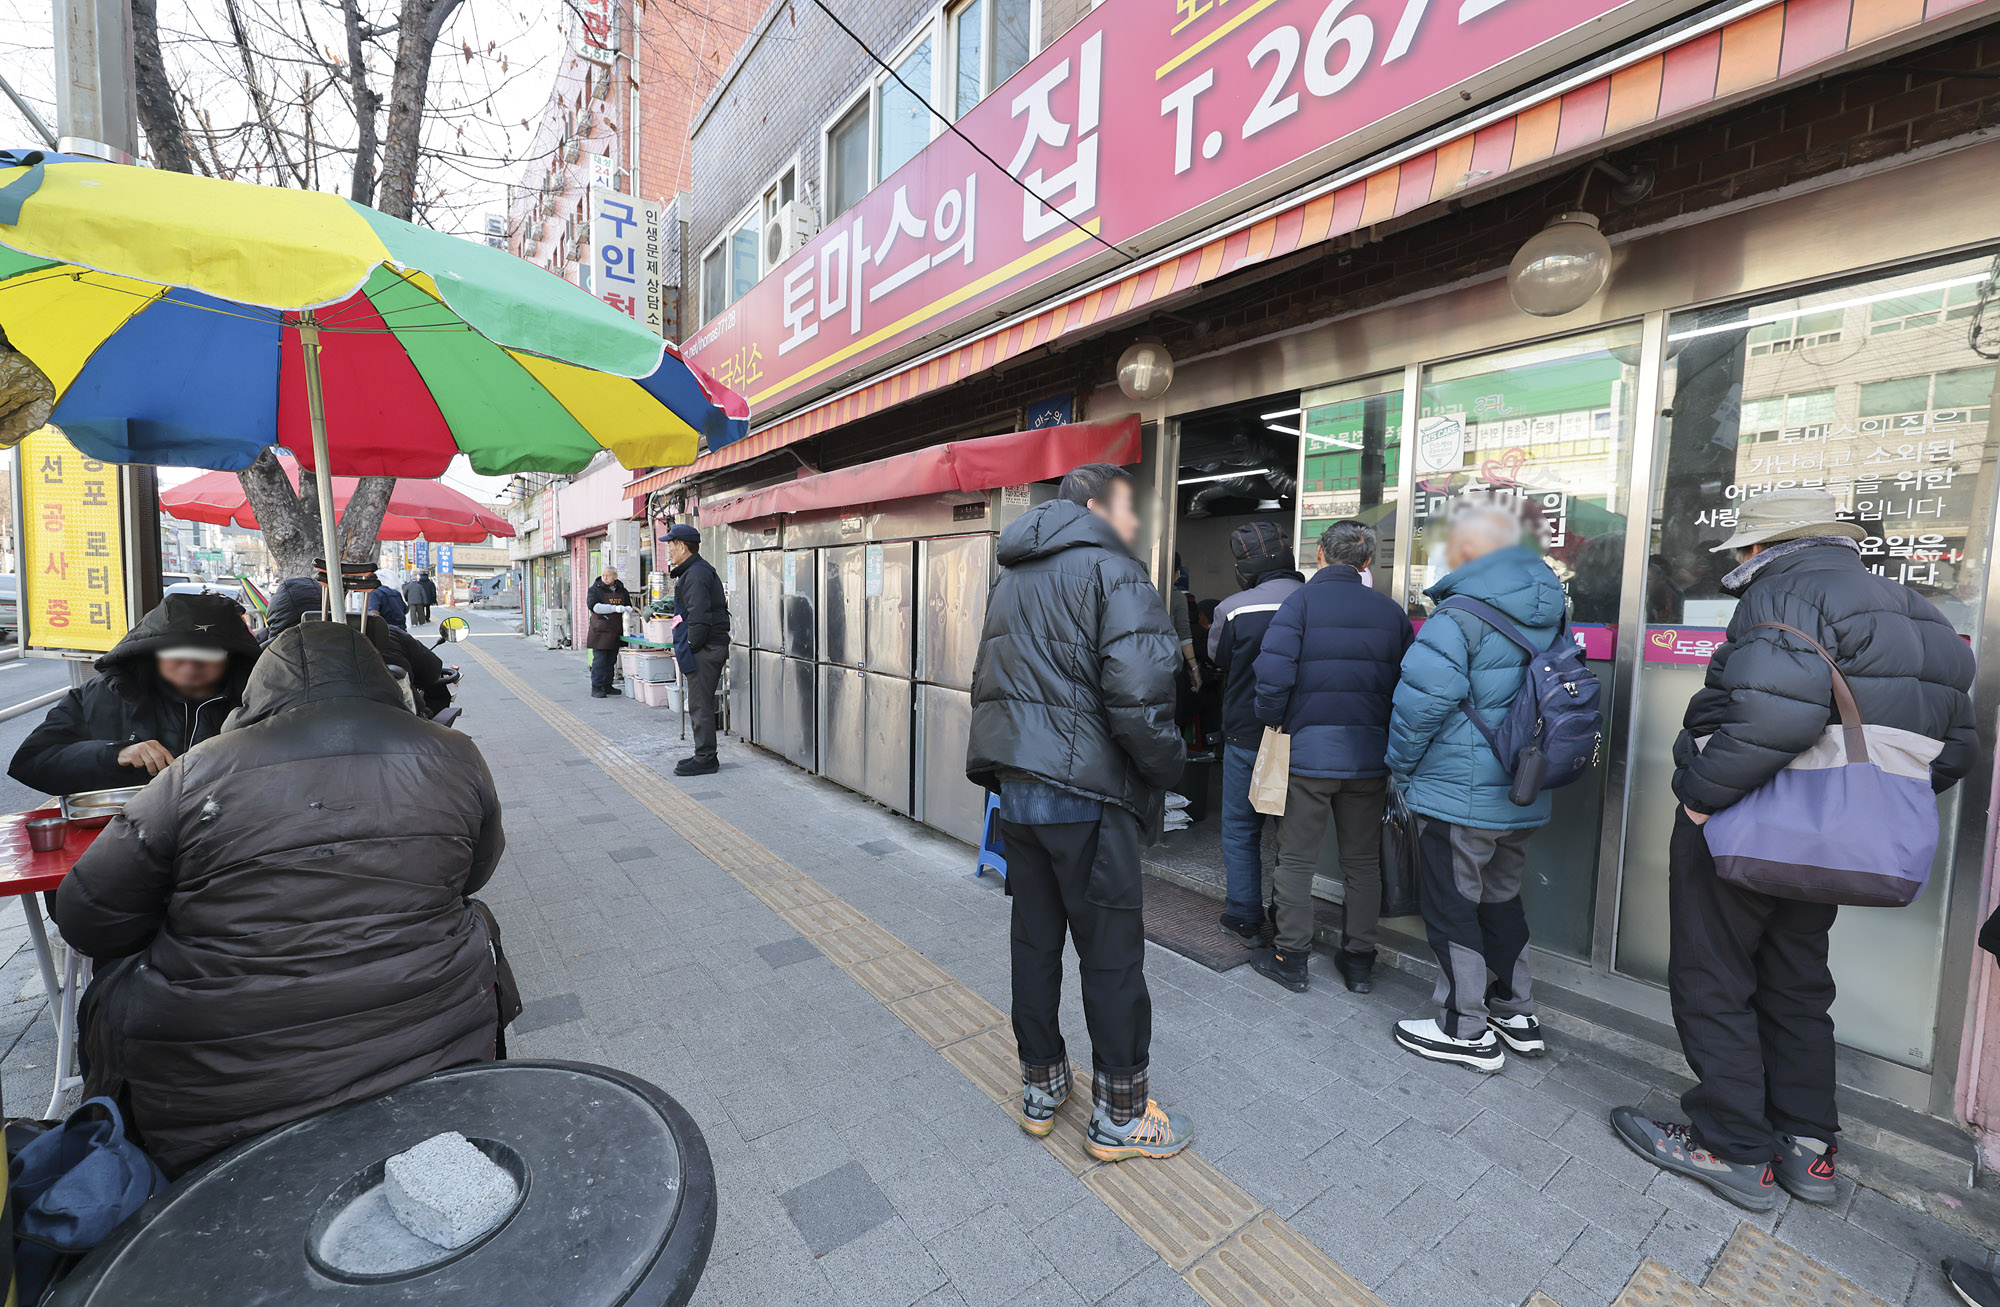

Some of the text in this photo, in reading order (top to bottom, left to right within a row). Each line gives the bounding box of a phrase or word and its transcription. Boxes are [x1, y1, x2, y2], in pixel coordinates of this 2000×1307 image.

[1242, 0, 1510, 139] 267
[779, 29, 1102, 356] 토마스의 집
[1750, 439, 1956, 475] 가난하고 소외된
[1777, 410, 1961, 446] 토마스의 집은
[1894, 467, 1957, 492] 위한
[85, 531, 110, 630] 로터리
